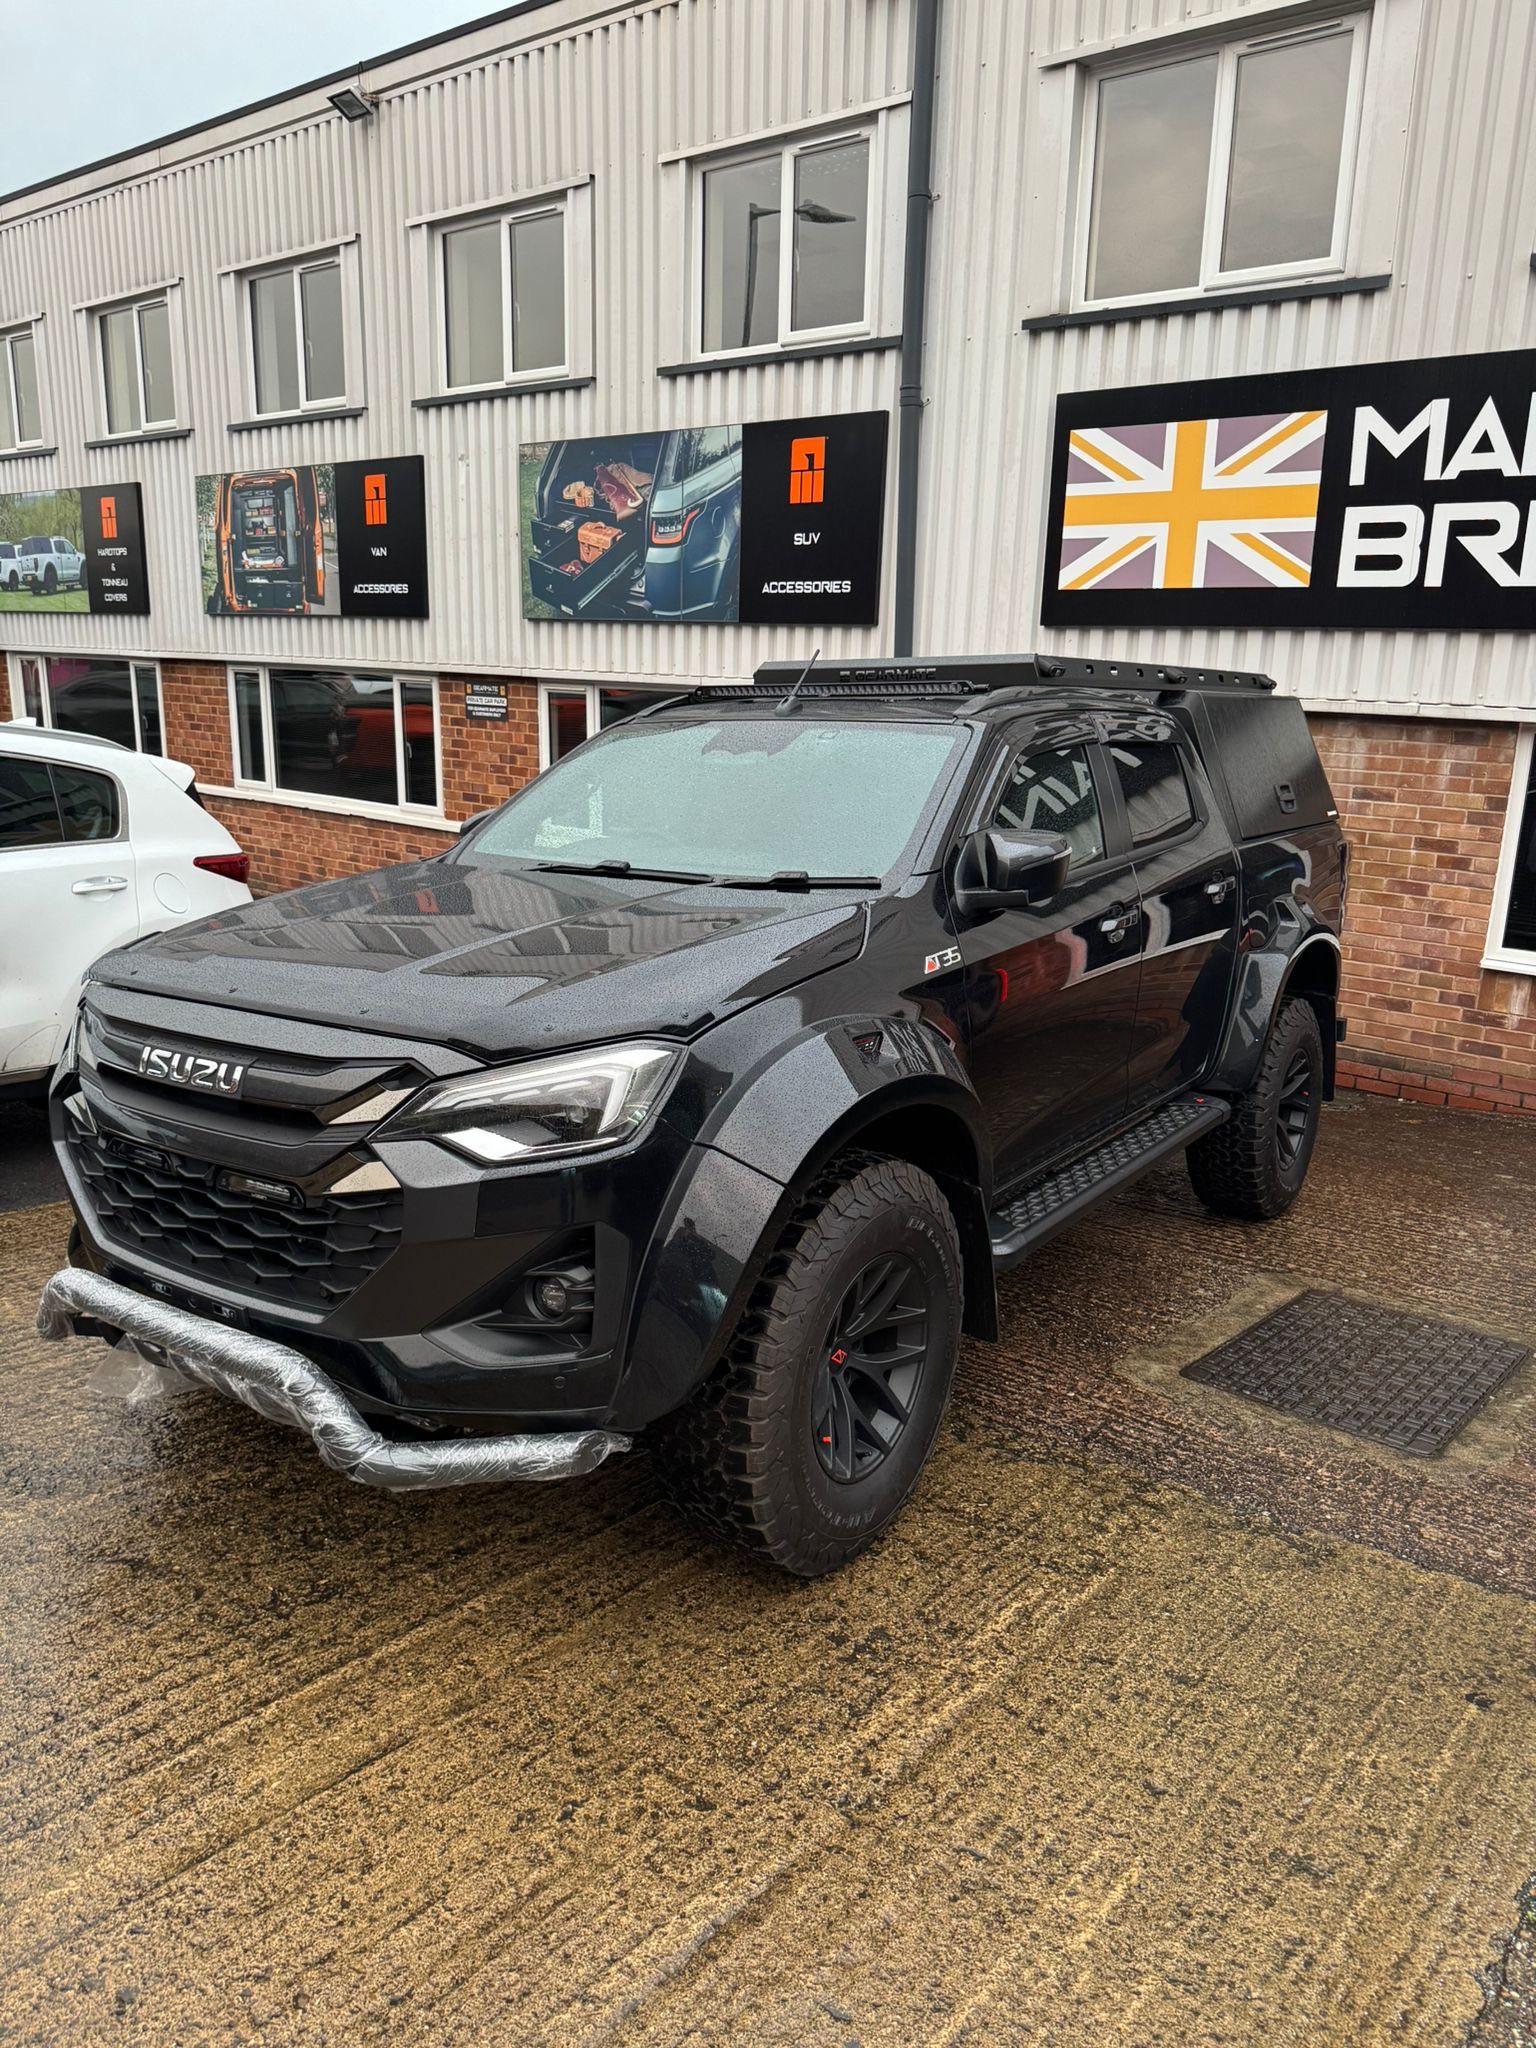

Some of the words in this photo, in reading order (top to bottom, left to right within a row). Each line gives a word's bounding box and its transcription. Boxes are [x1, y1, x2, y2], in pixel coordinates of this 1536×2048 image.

[793, 532, 821, 545] SUV
[97, 547, 128, 557] HARDTOPS
[370, 546, 388, 557] VAN
[101, 577, 129, 587] TONNEAU
[761, 580, 852, 594] ACCESSORIES
[353, 583, 409, 594] ACCESSORIES
[104, 593, 128, 602] COVERS
[855, 667, 937, 681] GEARMATE
[139, 1046, 244, 1094] ISUZU
